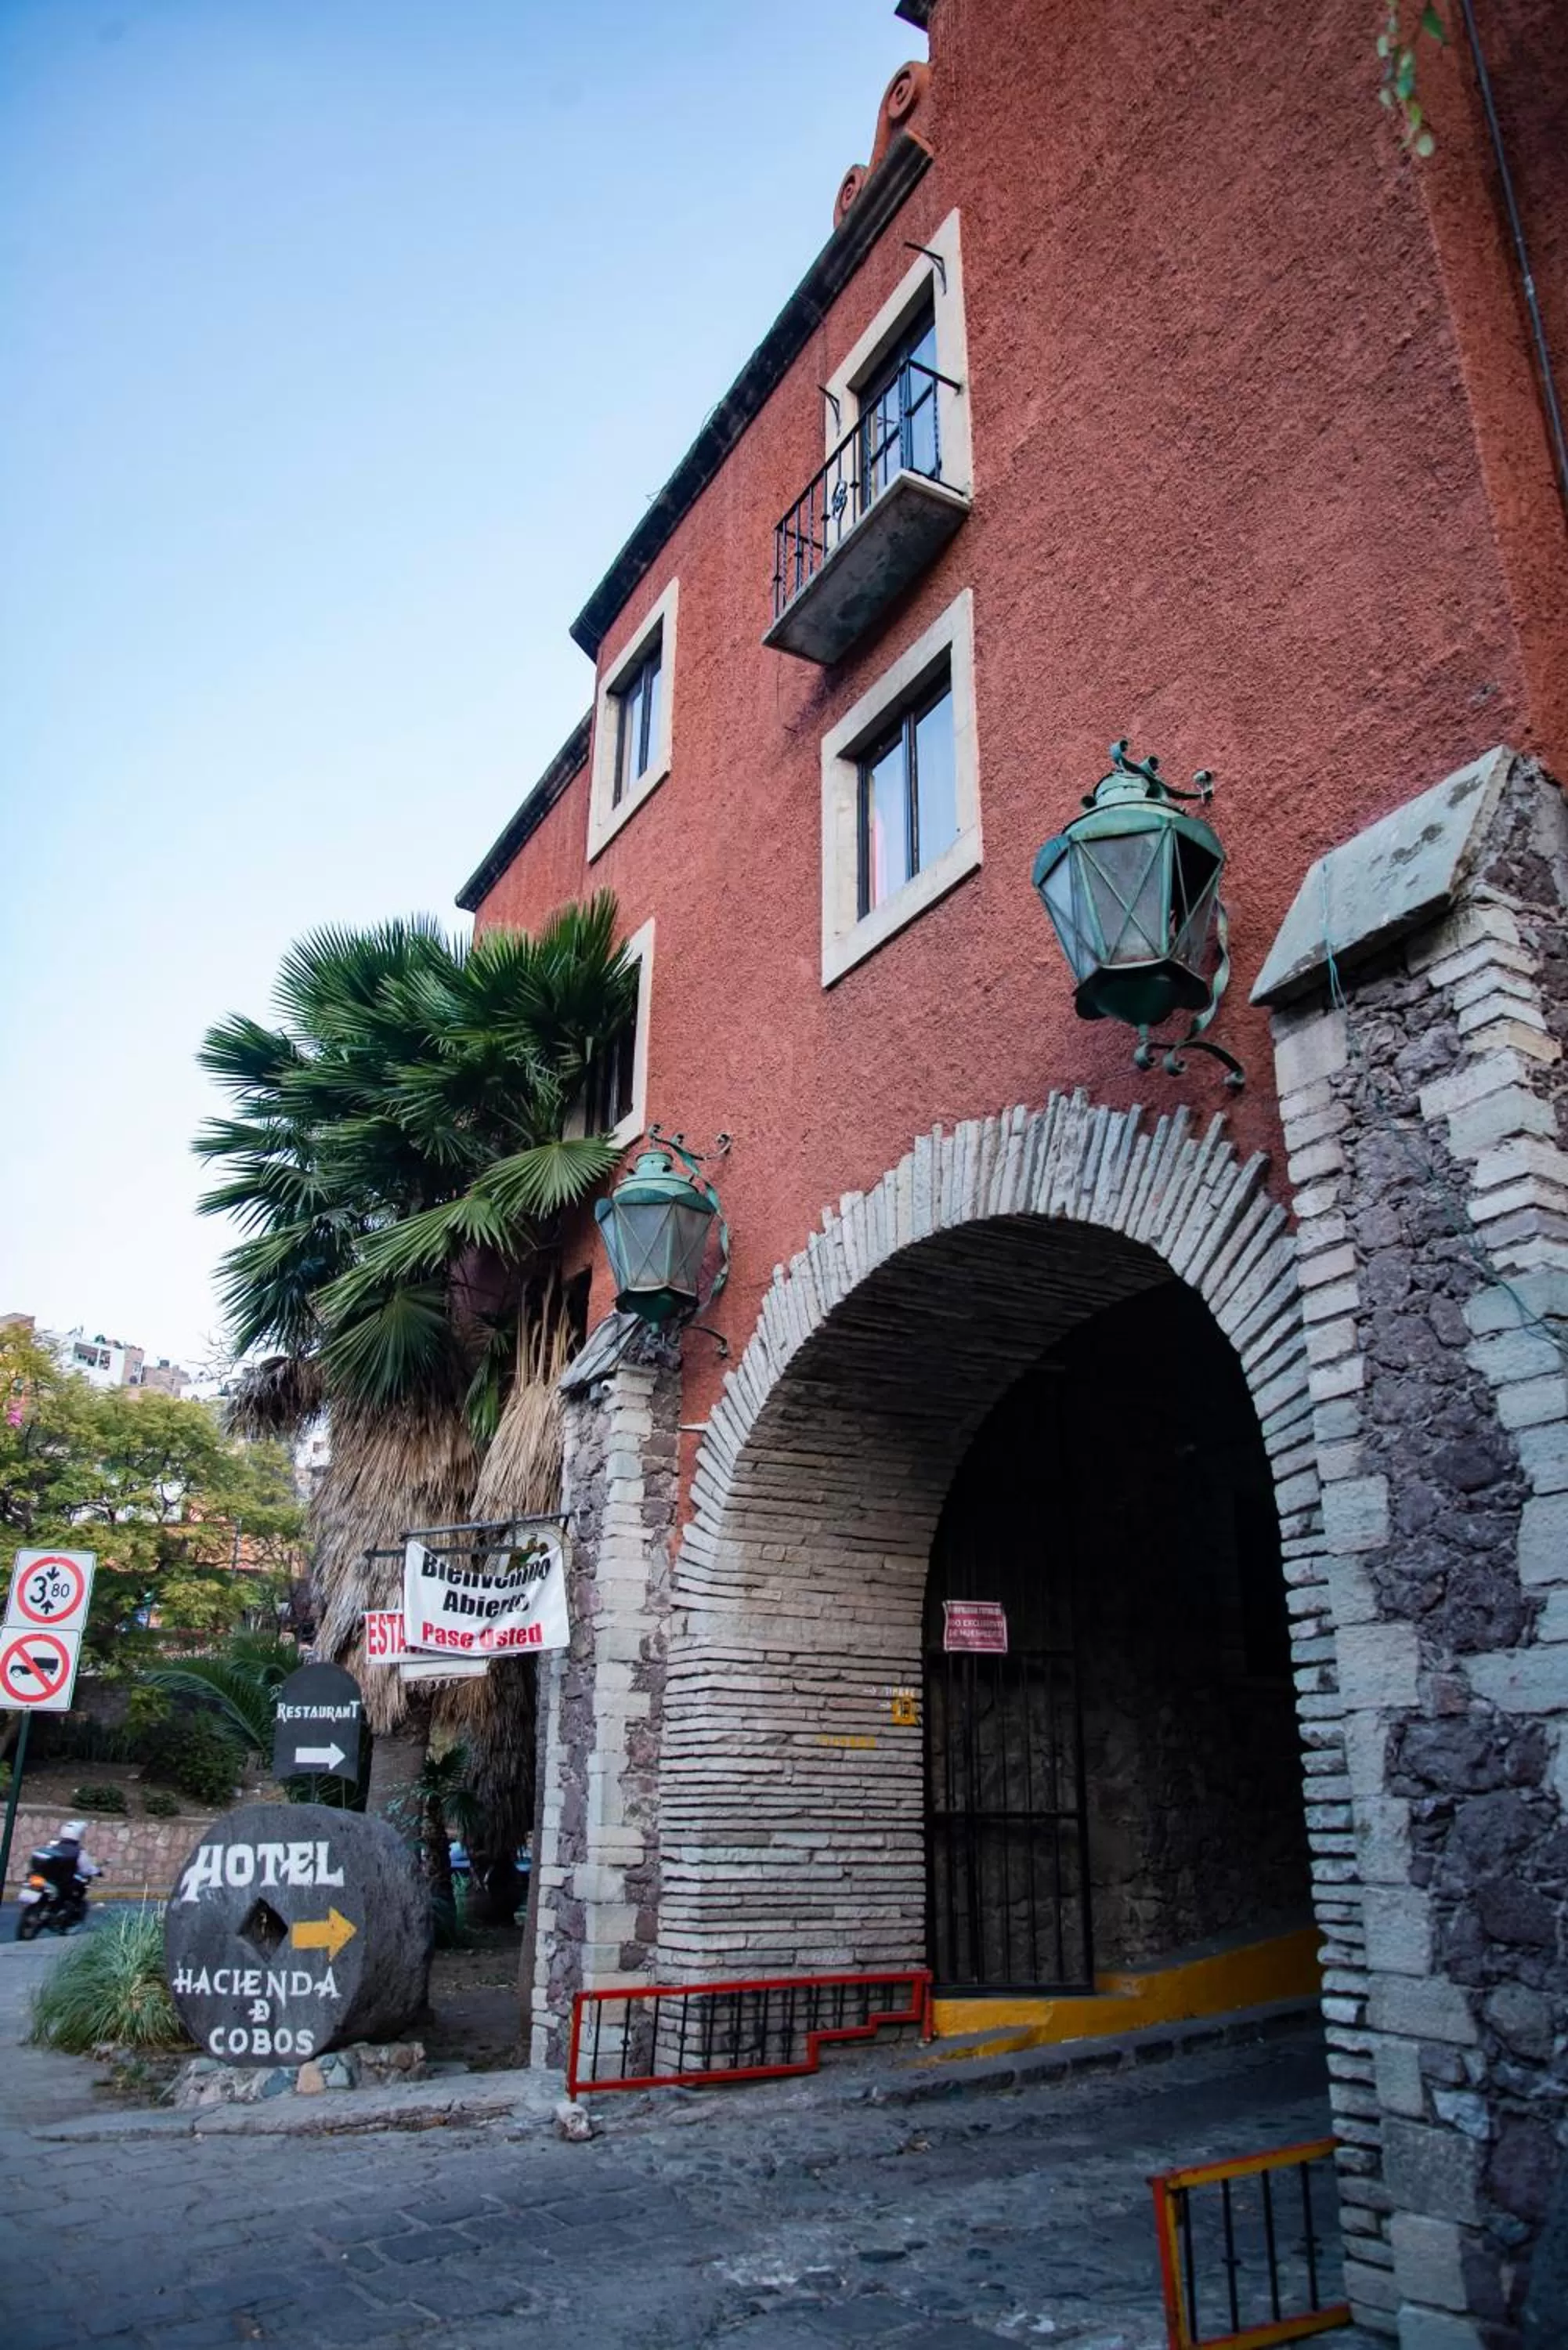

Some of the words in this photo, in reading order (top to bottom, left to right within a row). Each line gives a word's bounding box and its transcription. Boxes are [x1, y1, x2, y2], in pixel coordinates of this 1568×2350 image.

[422, 1621, 474, 1648] Pase
[276, 1700, 360, 1723] RESTAURANT
[180, 1842, 345, 1903] HOTEL
[172, 1965, 342, 2007] HACIENDA
[208, 2026, 316, 2055] COBOS
